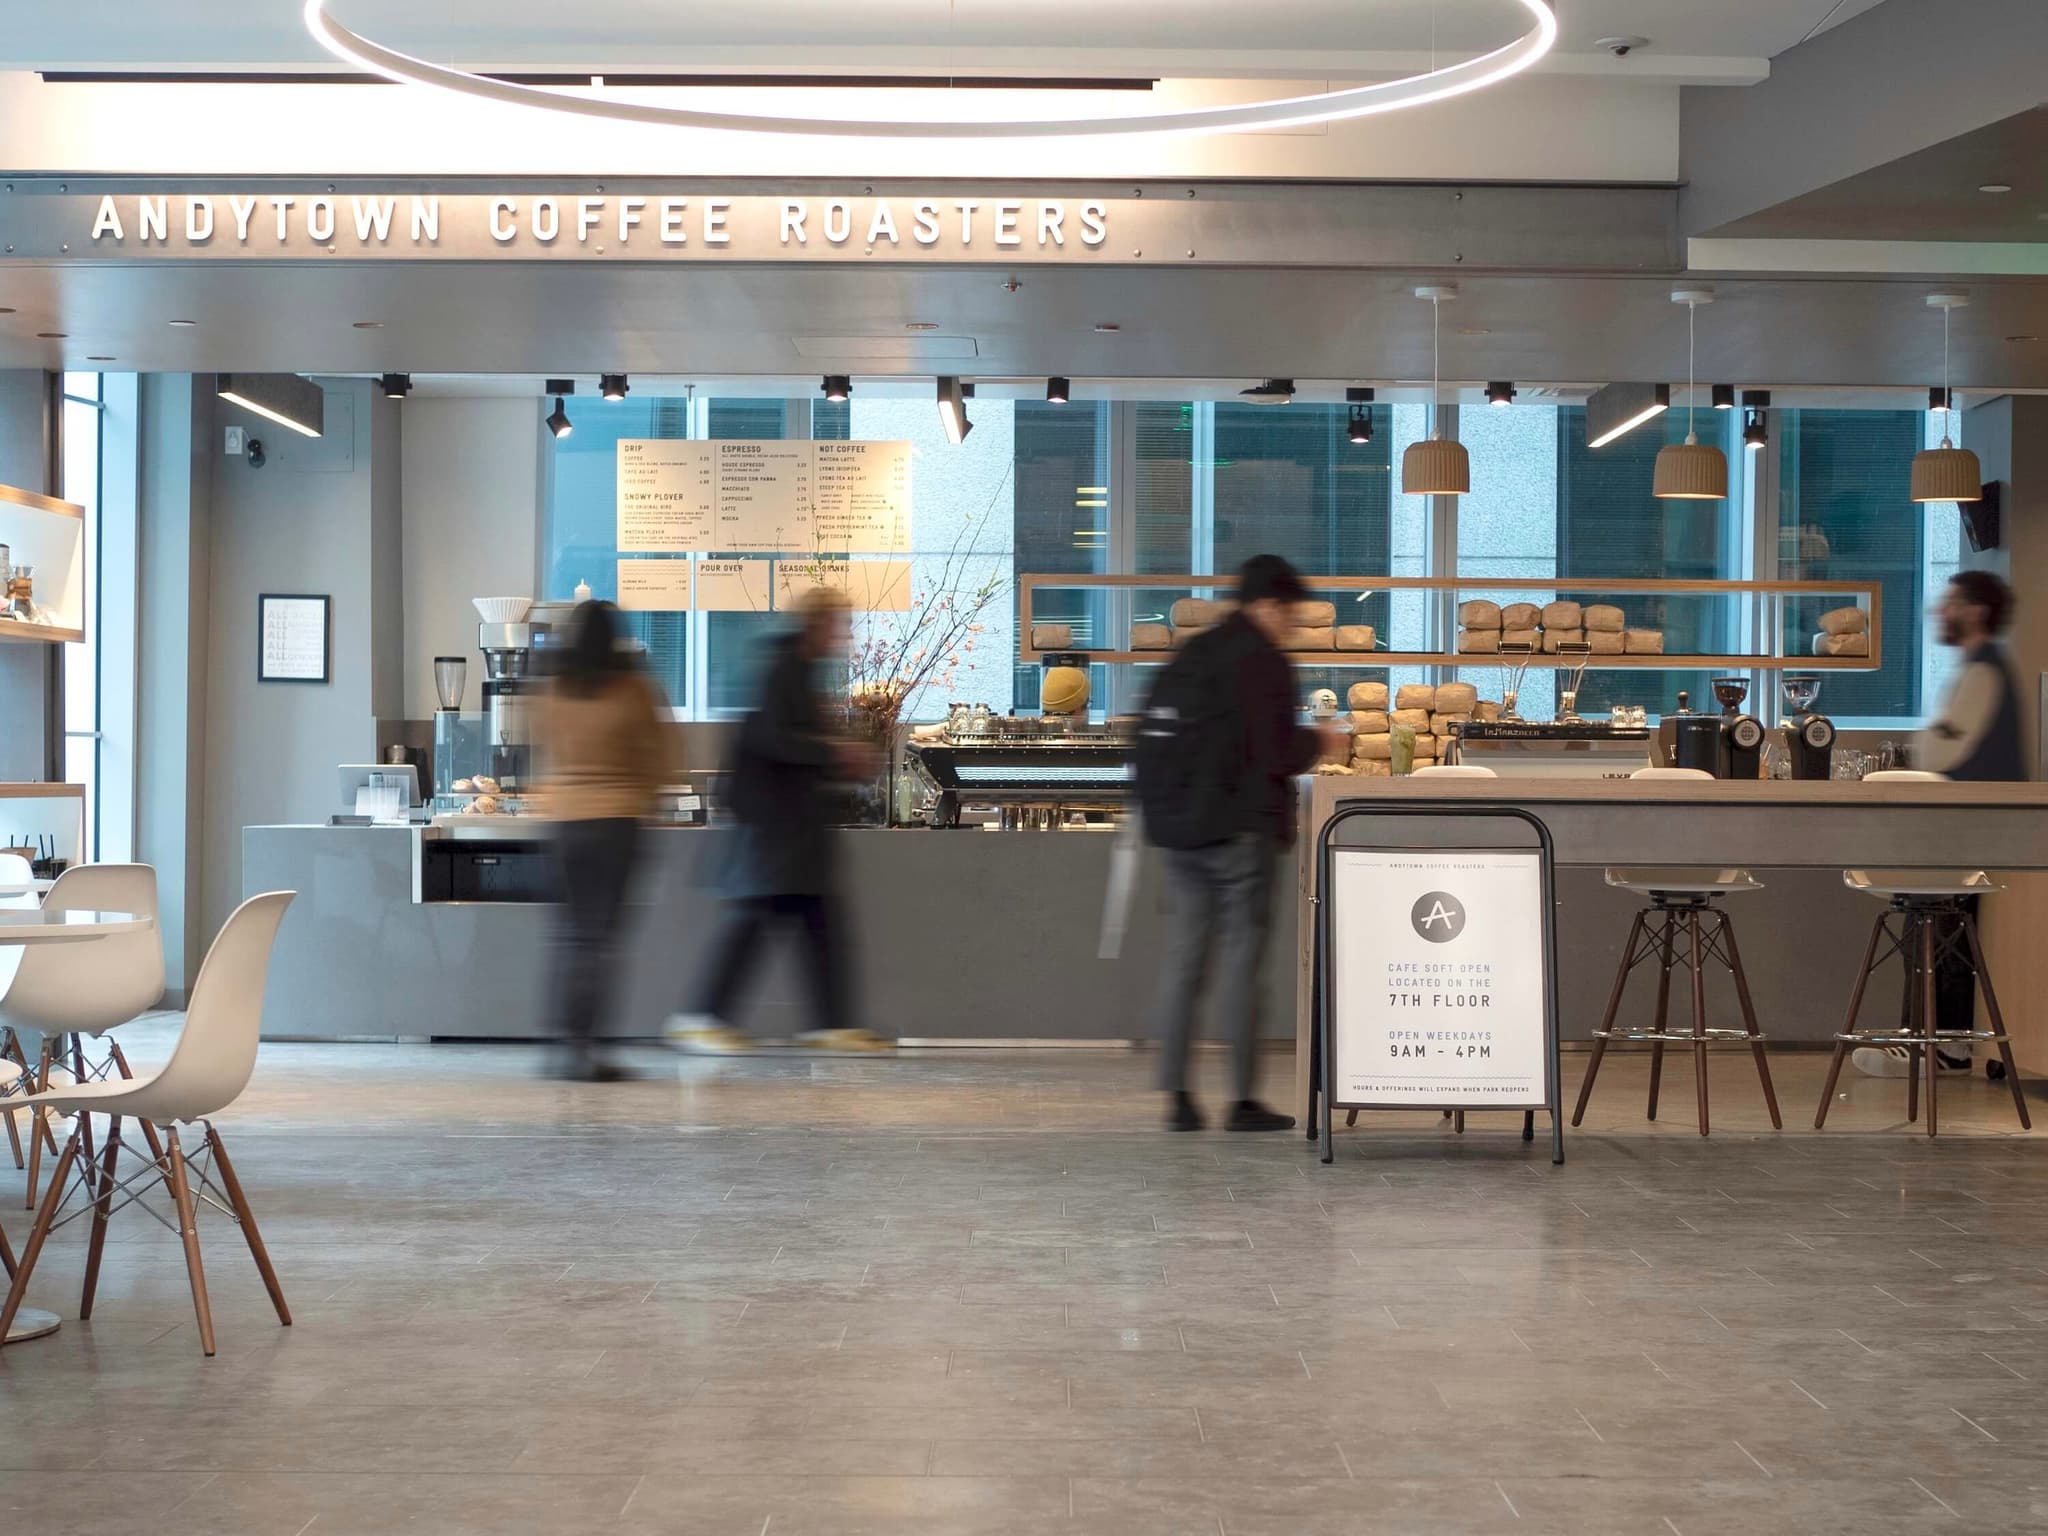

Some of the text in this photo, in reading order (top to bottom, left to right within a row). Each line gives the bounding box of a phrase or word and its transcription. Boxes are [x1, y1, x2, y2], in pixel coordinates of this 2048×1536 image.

[91, 195, 1107, 244] ANDYTOWN COFFEE ROASTERS
[624, 445, 643, 453] DRIP
[721, 445, 761, 453] ESPRESSO
[819, 445, 866, 453] NOT COFFEE
[624, 493, 684, 501] SNOWY PLOVER
[700, 564, 743, 572] POUR OVER
[1388, 963, 1490, 973] CAFE SOFT OPEN
[1388, 978, 1491, 987] LOCATED ON THE
[1390, 994, 1490, 1007] 7TH FLOOR
[1389, 1031, 1492, 1040] OPEN WEEKDAYS
[1390, 1044, 1426, 1058] 9AM
[1455, 1044, 1490, 1058] 4PM
